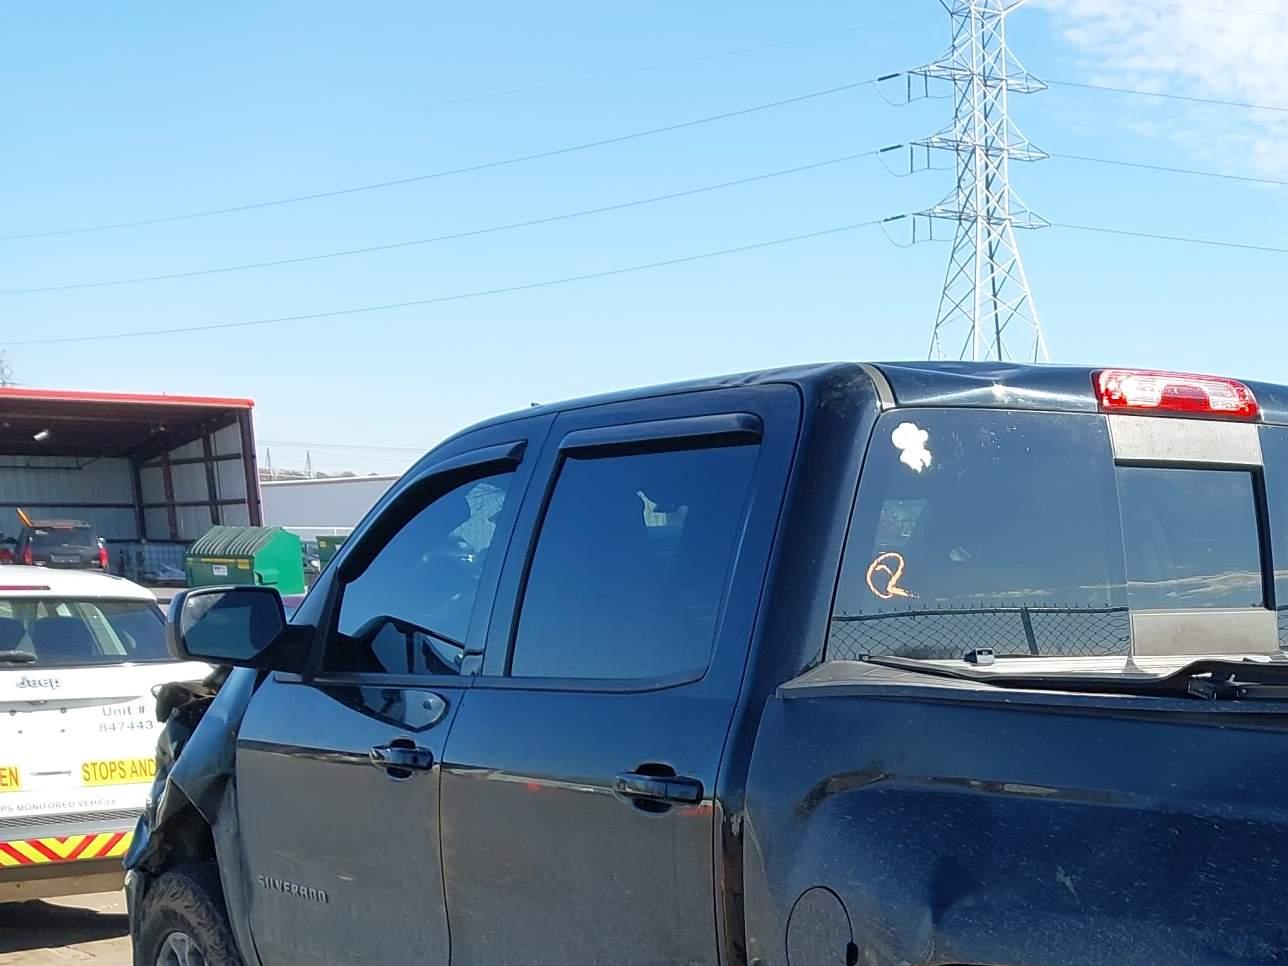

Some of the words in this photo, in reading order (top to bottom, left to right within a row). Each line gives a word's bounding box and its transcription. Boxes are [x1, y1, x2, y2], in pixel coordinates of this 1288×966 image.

[16, 675, 62, 691] Jeep
[102, 705, 132, 717] Unit
[98, 719, 154, 733] 847443
[81, 760, 127, 783] STOPS
[129, 758, 156, 779] AND
[16, 800, 75, 812] MONITORED
[78, 798, 118, 808] VEHICLE
[258, 875, 328, 904] SILVERADO
